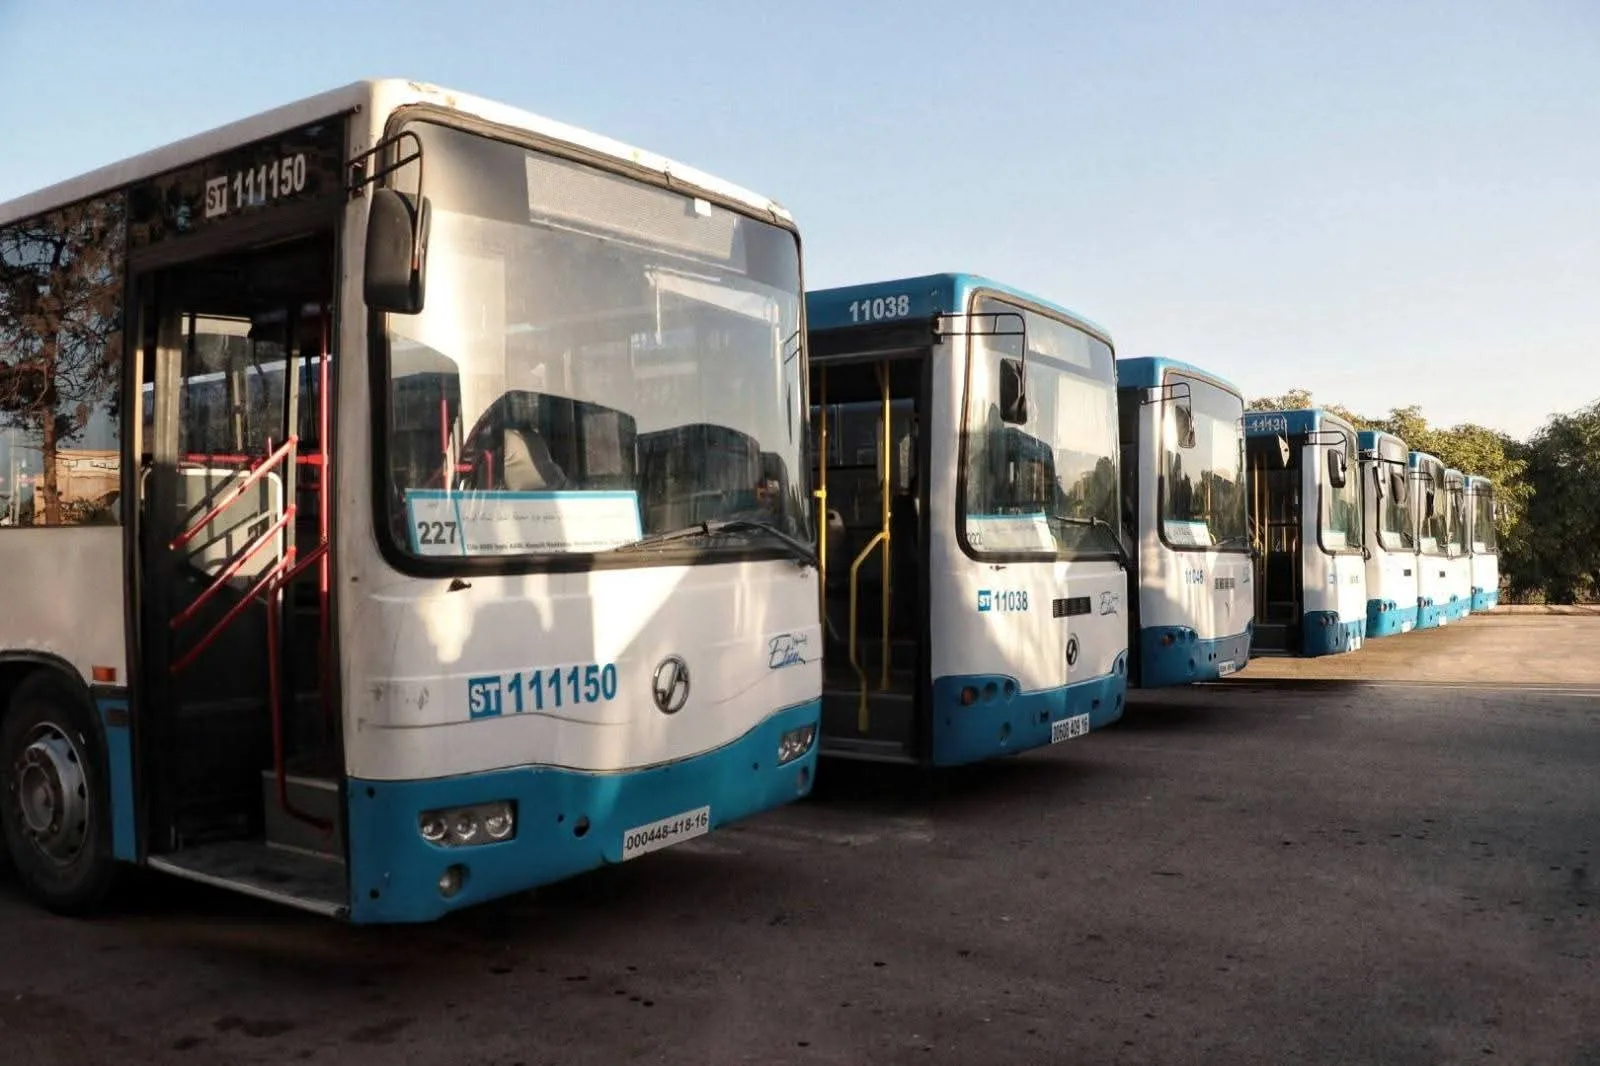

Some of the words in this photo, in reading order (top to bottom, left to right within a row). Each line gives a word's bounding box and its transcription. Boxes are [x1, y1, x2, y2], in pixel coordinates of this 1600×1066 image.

[207, 181, 226, 211] ST
[233, 153, 306, 208] 111150
[849, 294, 909, 322] 11038
[418, 521, 457, 545] 227
[994, 591, 1028, 611] 11038
[470, 680, 501, 715] ST
[508, 663, 617, 713] 111150
